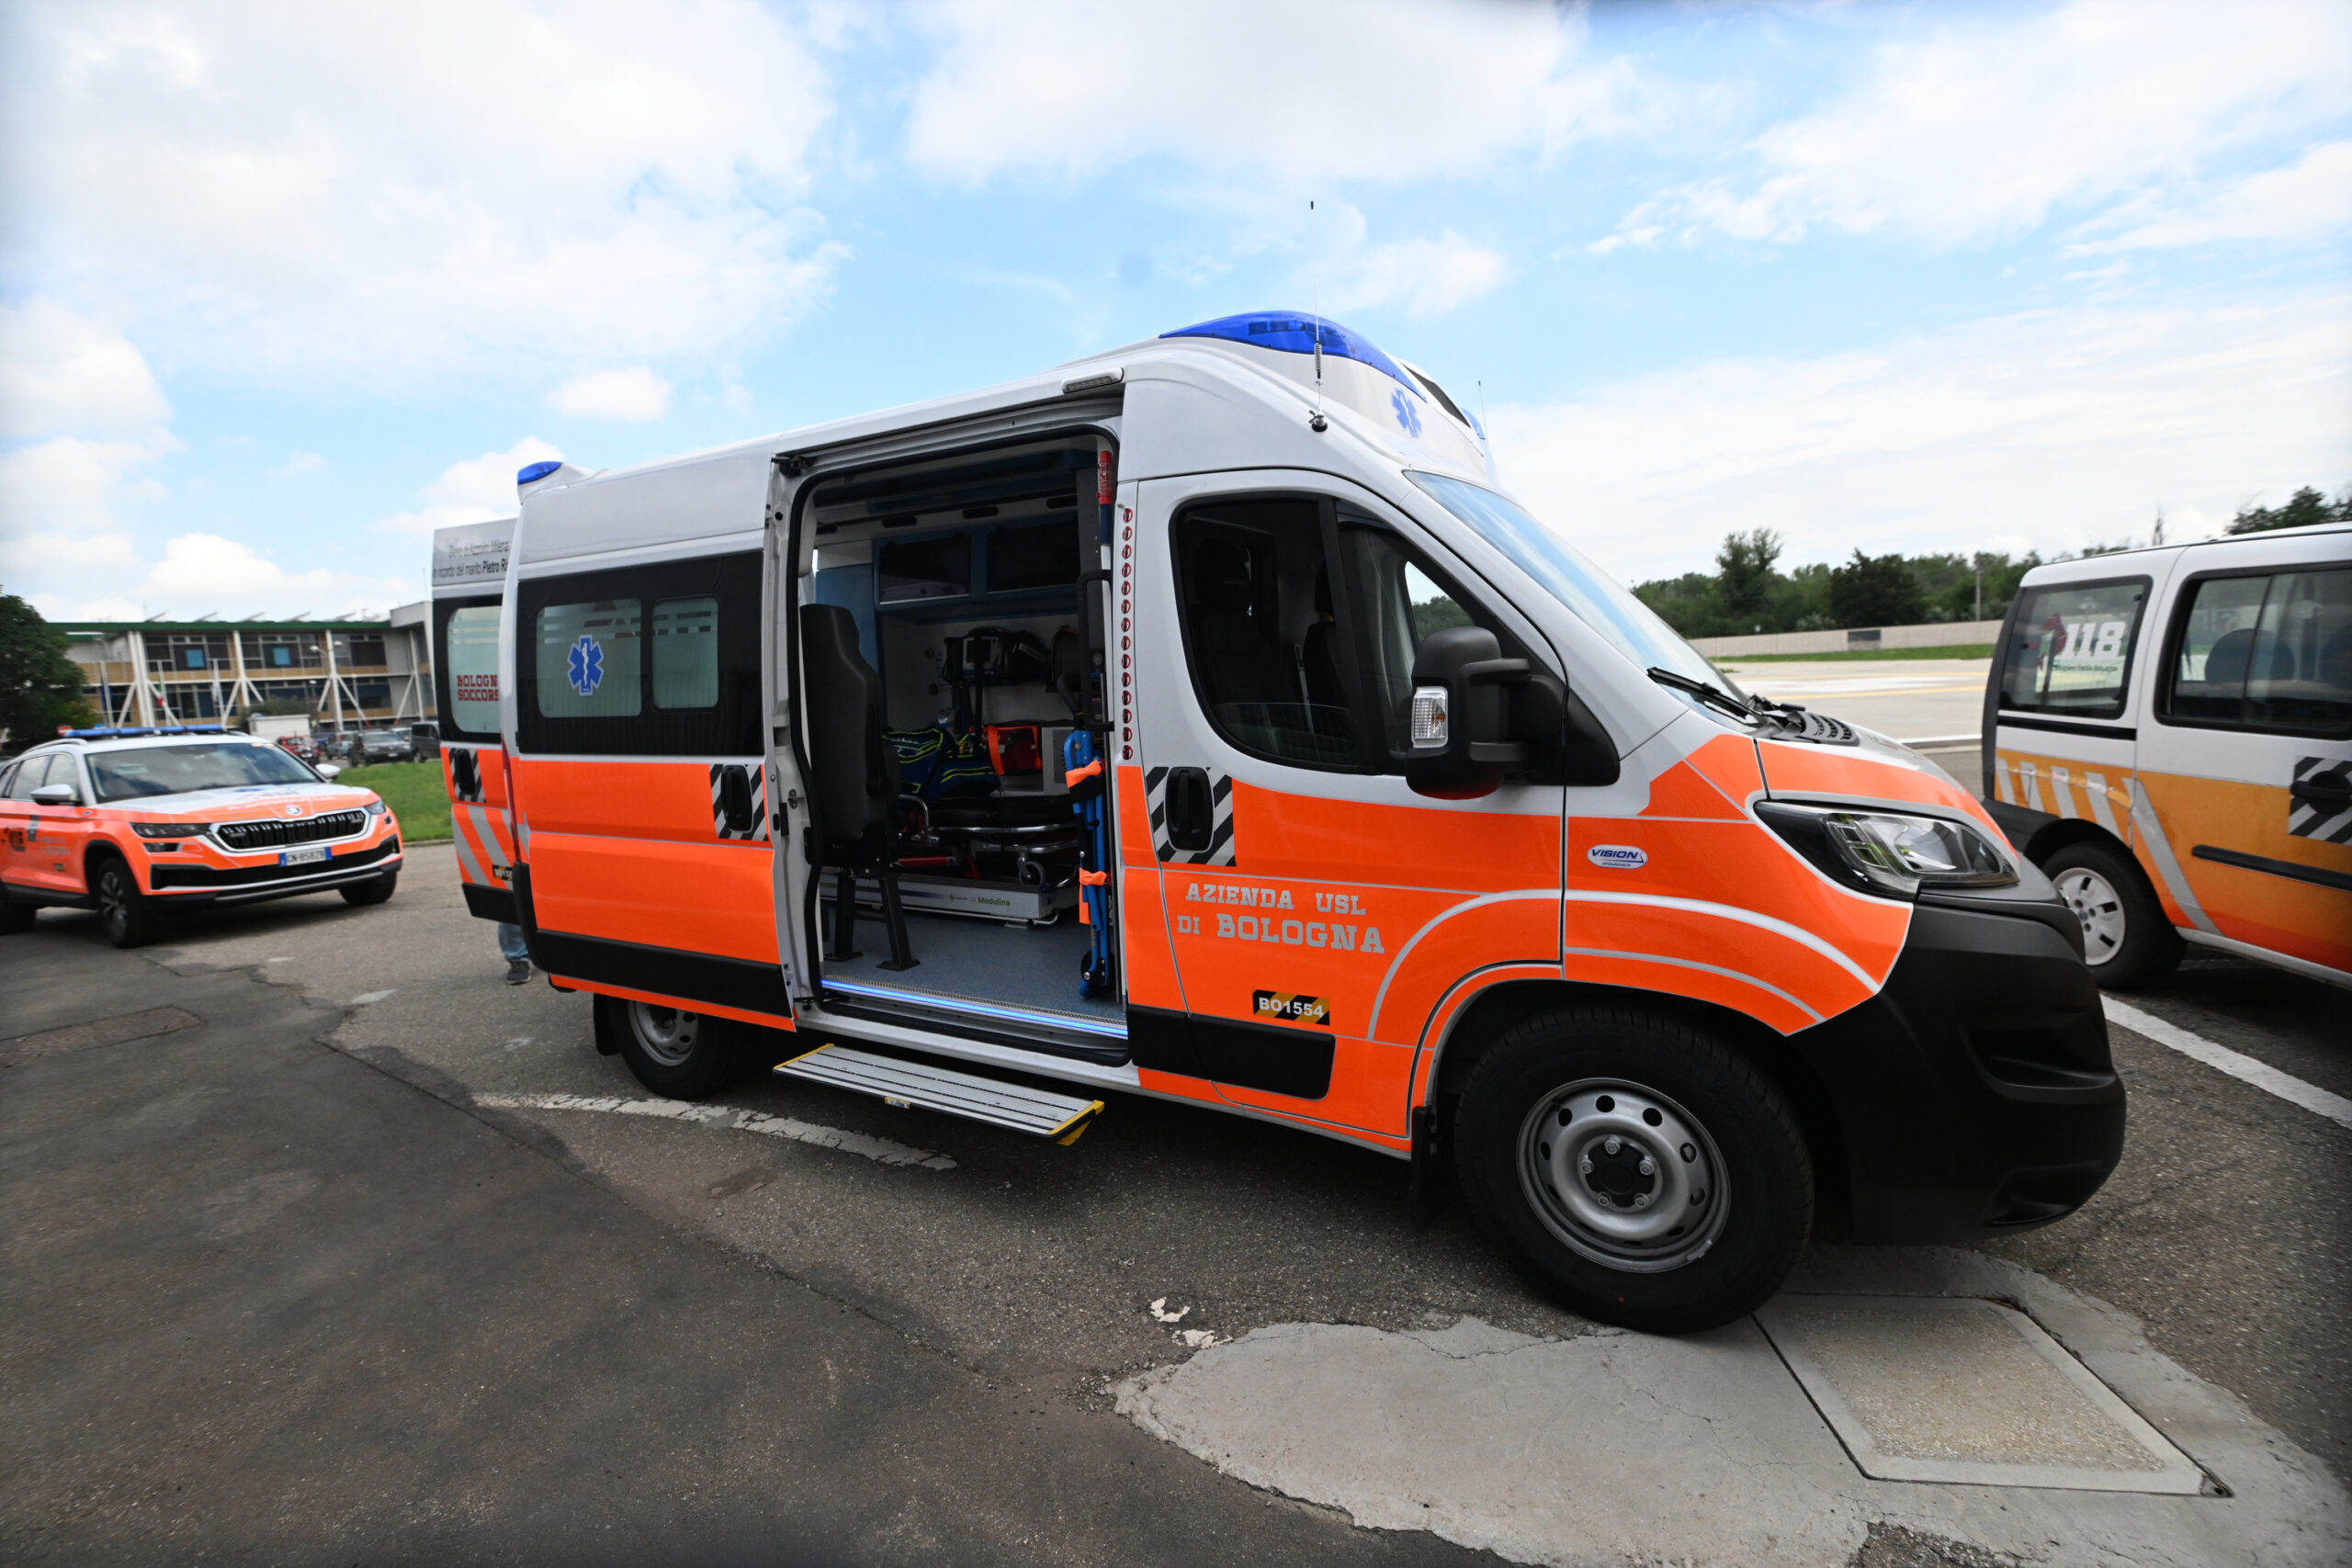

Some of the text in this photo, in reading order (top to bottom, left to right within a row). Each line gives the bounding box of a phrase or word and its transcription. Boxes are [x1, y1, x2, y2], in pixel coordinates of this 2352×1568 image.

[482, 558, 500, 574] Pietro
[2062, 621, 2126, 660] 118
[456, 674, 498, 687] BOLOGN
[458, 689, 499, 702] SOCCORS
[1592, 849, 1639, 859] VISION
[978, 897, 1011, 907] Moduline
[1185, 883, 1367, 916] AZIENDA USL
[1177, 913, 1385, 954] DI BOLOGNA
[1258, 997, 1325, 1019] BO1554
